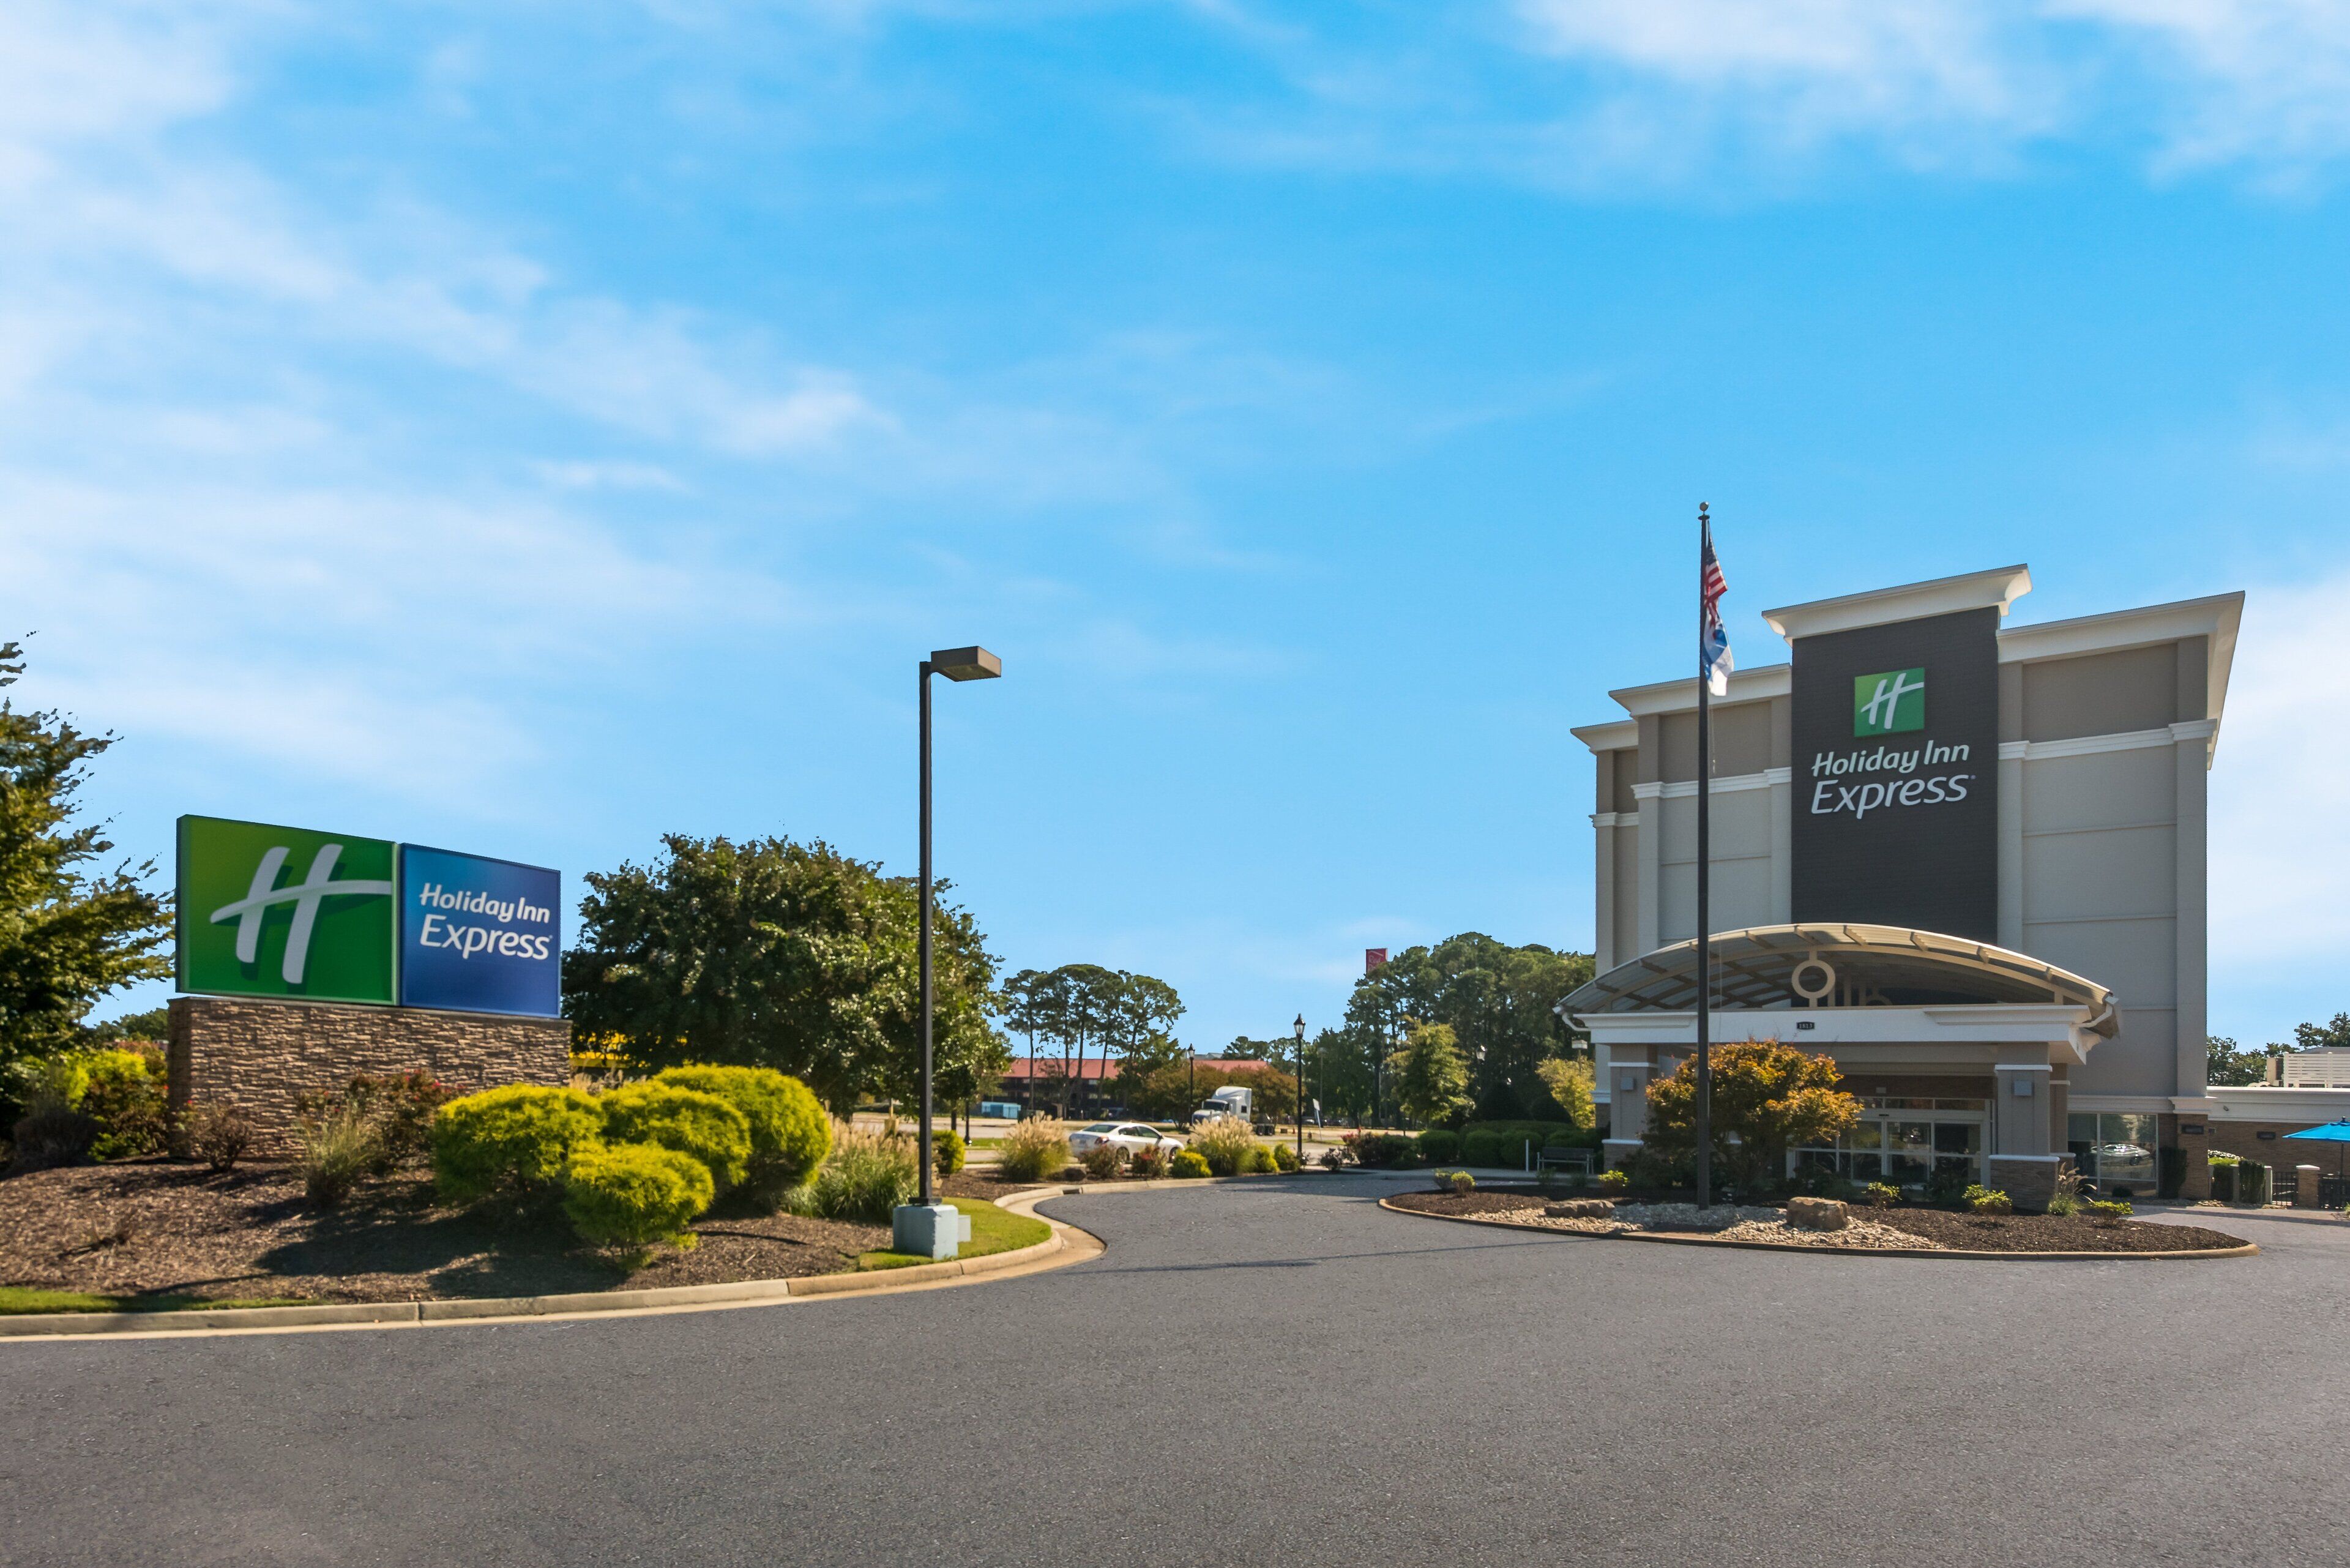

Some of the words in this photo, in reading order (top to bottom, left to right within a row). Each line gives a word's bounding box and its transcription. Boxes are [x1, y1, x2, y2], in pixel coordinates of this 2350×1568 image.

[1811, 746, 1920, 777] Holiday
[1923, 740, 1970, 765] Inn
[1811, 774, 1969, 819] Express
[419, 882, 515, 923] Holiday
[517, 897, 550, 924] Inn
[420, 913, 550, 960] Express
